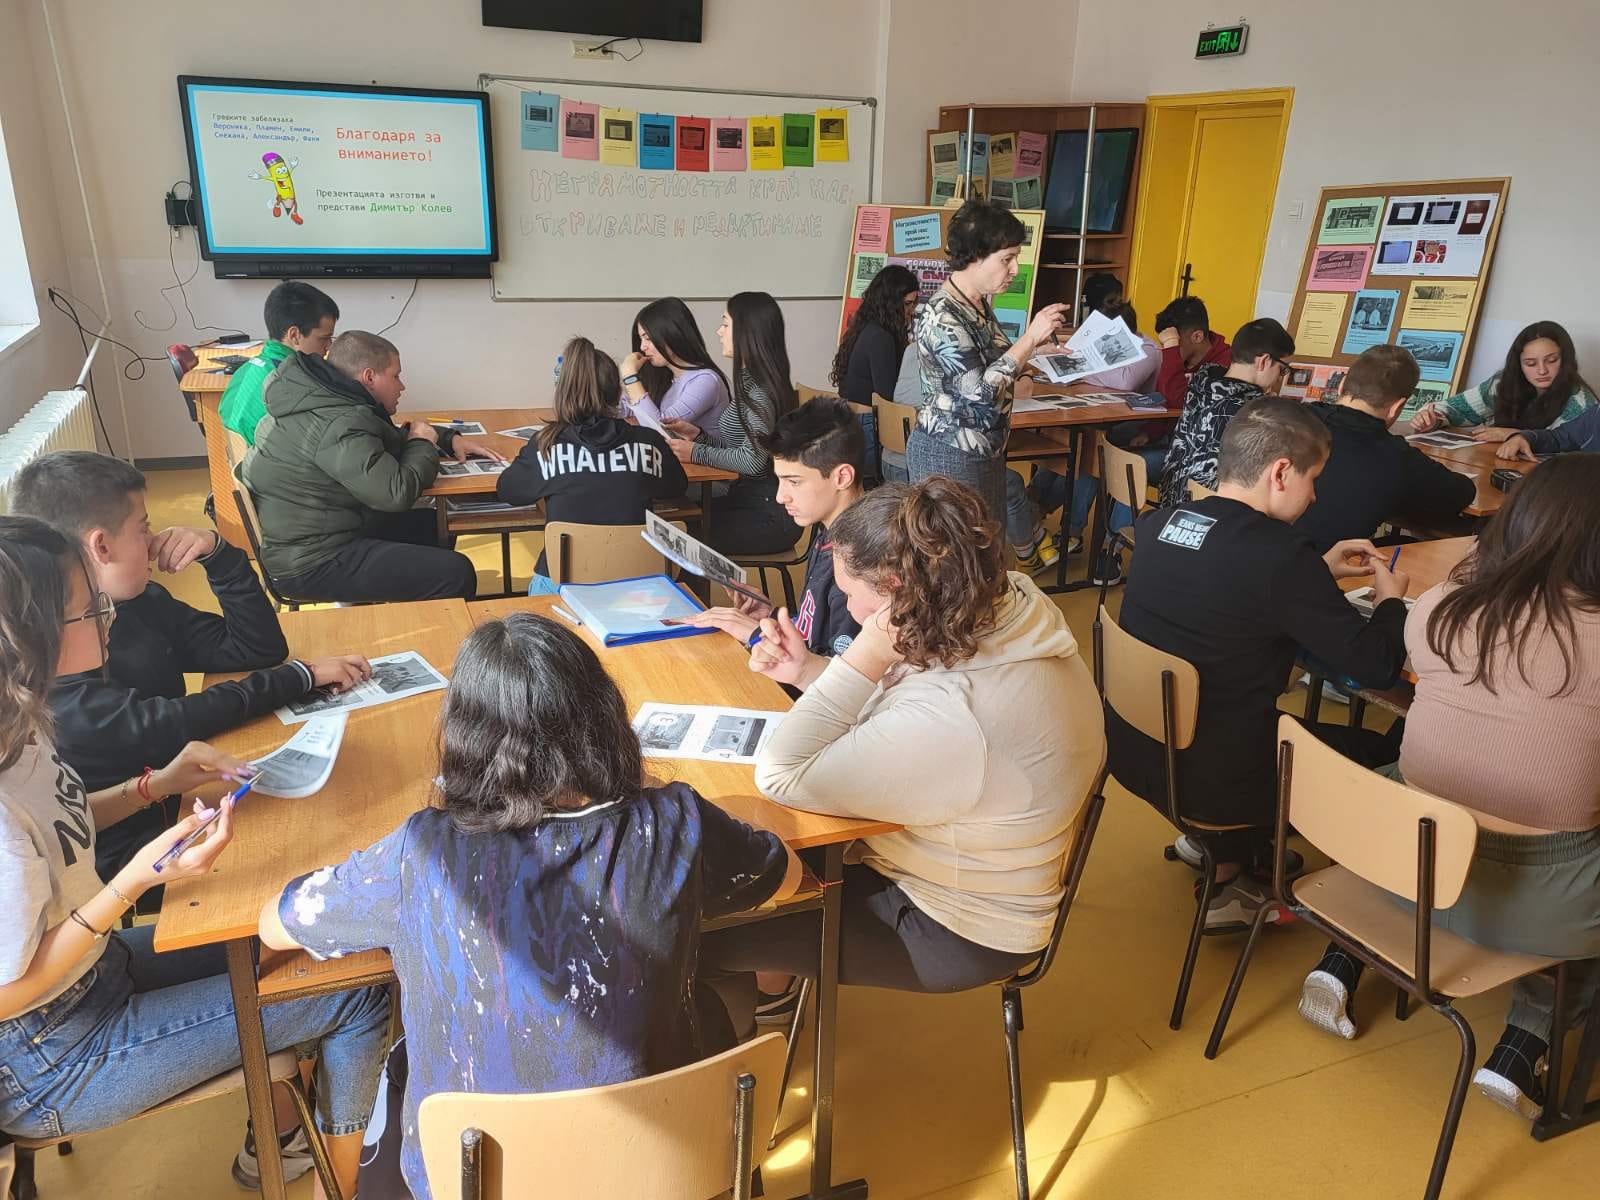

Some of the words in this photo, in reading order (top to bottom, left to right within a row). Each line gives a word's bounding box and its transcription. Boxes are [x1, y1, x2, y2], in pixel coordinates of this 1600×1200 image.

[1200, 40, 1217, 52] EXIT
[213, 122, 251, 131] Вероника,
[255, 124, 285, 132] Пламен,
[214, 131, 249, 140] Снежана,
[253, 133, 299, 142] Александър,
[336, 127, 416, 144] Благодаря
[424, 132, 442, 143] за
[338, 149, 433, 162] вниманието!
[529, 168, 737, 202] НЕГРАМОТНОСТТА
[748, 171, 801, 202] КРАЙ
[316, 189, 385, 199] Презентацията
[390, 191, 426, 199] изготви
[318, 203, 366, 212] представи
[370, 202, 415, 213] Димитър
[420, 203, 453, 213] Колев
[537, 442, 663, 481] WHATEVER
[1162, 525, 1204, 547] PAUSE
